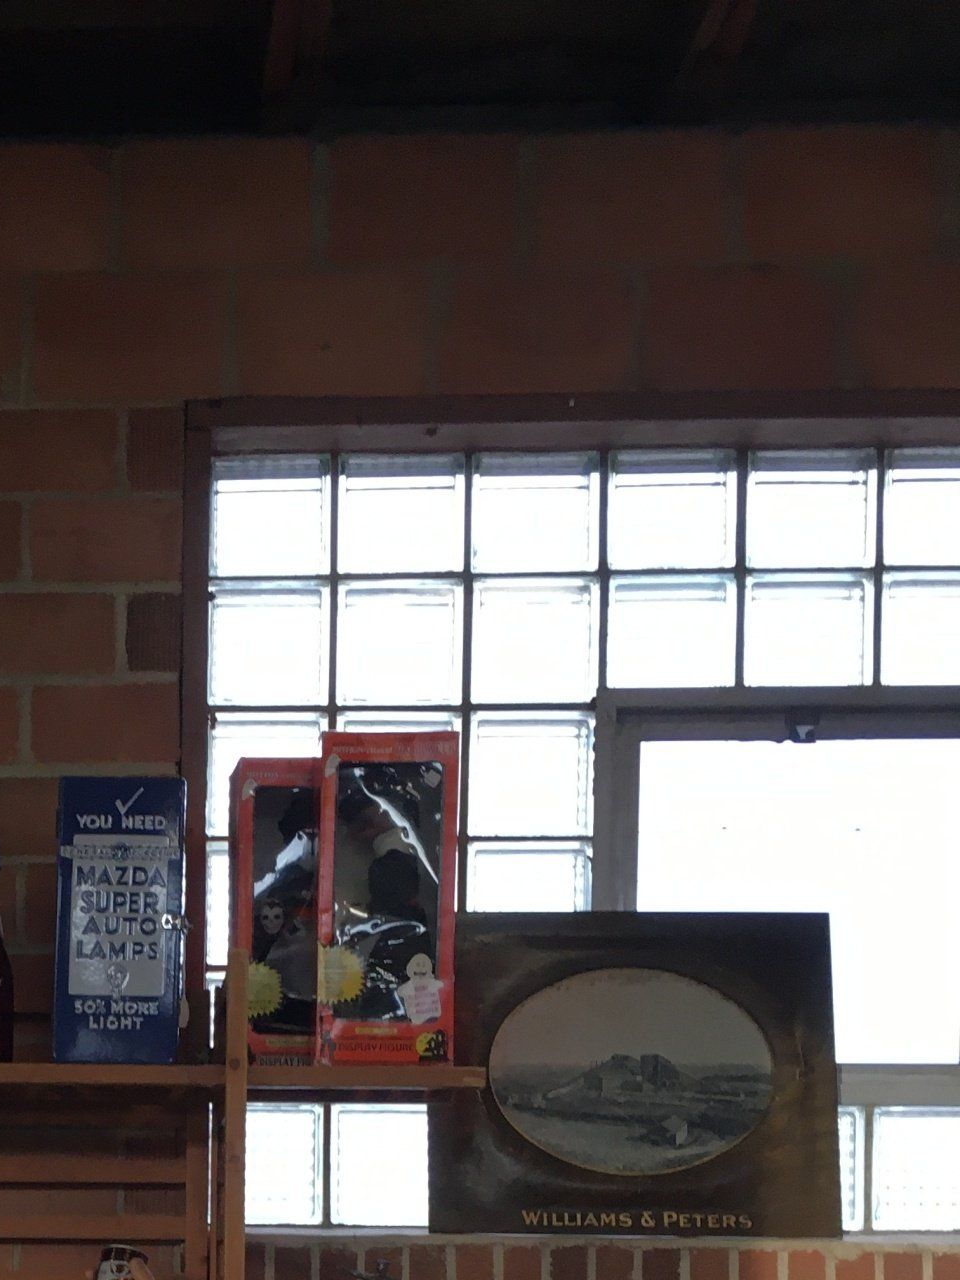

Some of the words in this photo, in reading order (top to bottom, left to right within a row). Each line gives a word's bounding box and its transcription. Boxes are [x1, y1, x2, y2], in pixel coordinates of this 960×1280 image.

[76, 814, 112, 829] YOU
[121, 814, 167, 830] NEED
[76, 865, 167, 887] MAZDA
[80, 891, 159, 914] SUPER
[82, 915, 158, 936] AUTO
[76, 941, 159, 961] LAMPS
[74, 1001, 106, 1015] 50%
[110, 1000, 159, 1015] MORE
[89, 1016, 144, 1030] LIGHT
[521, 1209, 633, 1229] WILLIAMS
[640, 1210, 656, 1229] &
[662, 1210, 753, 1230] PETERS
